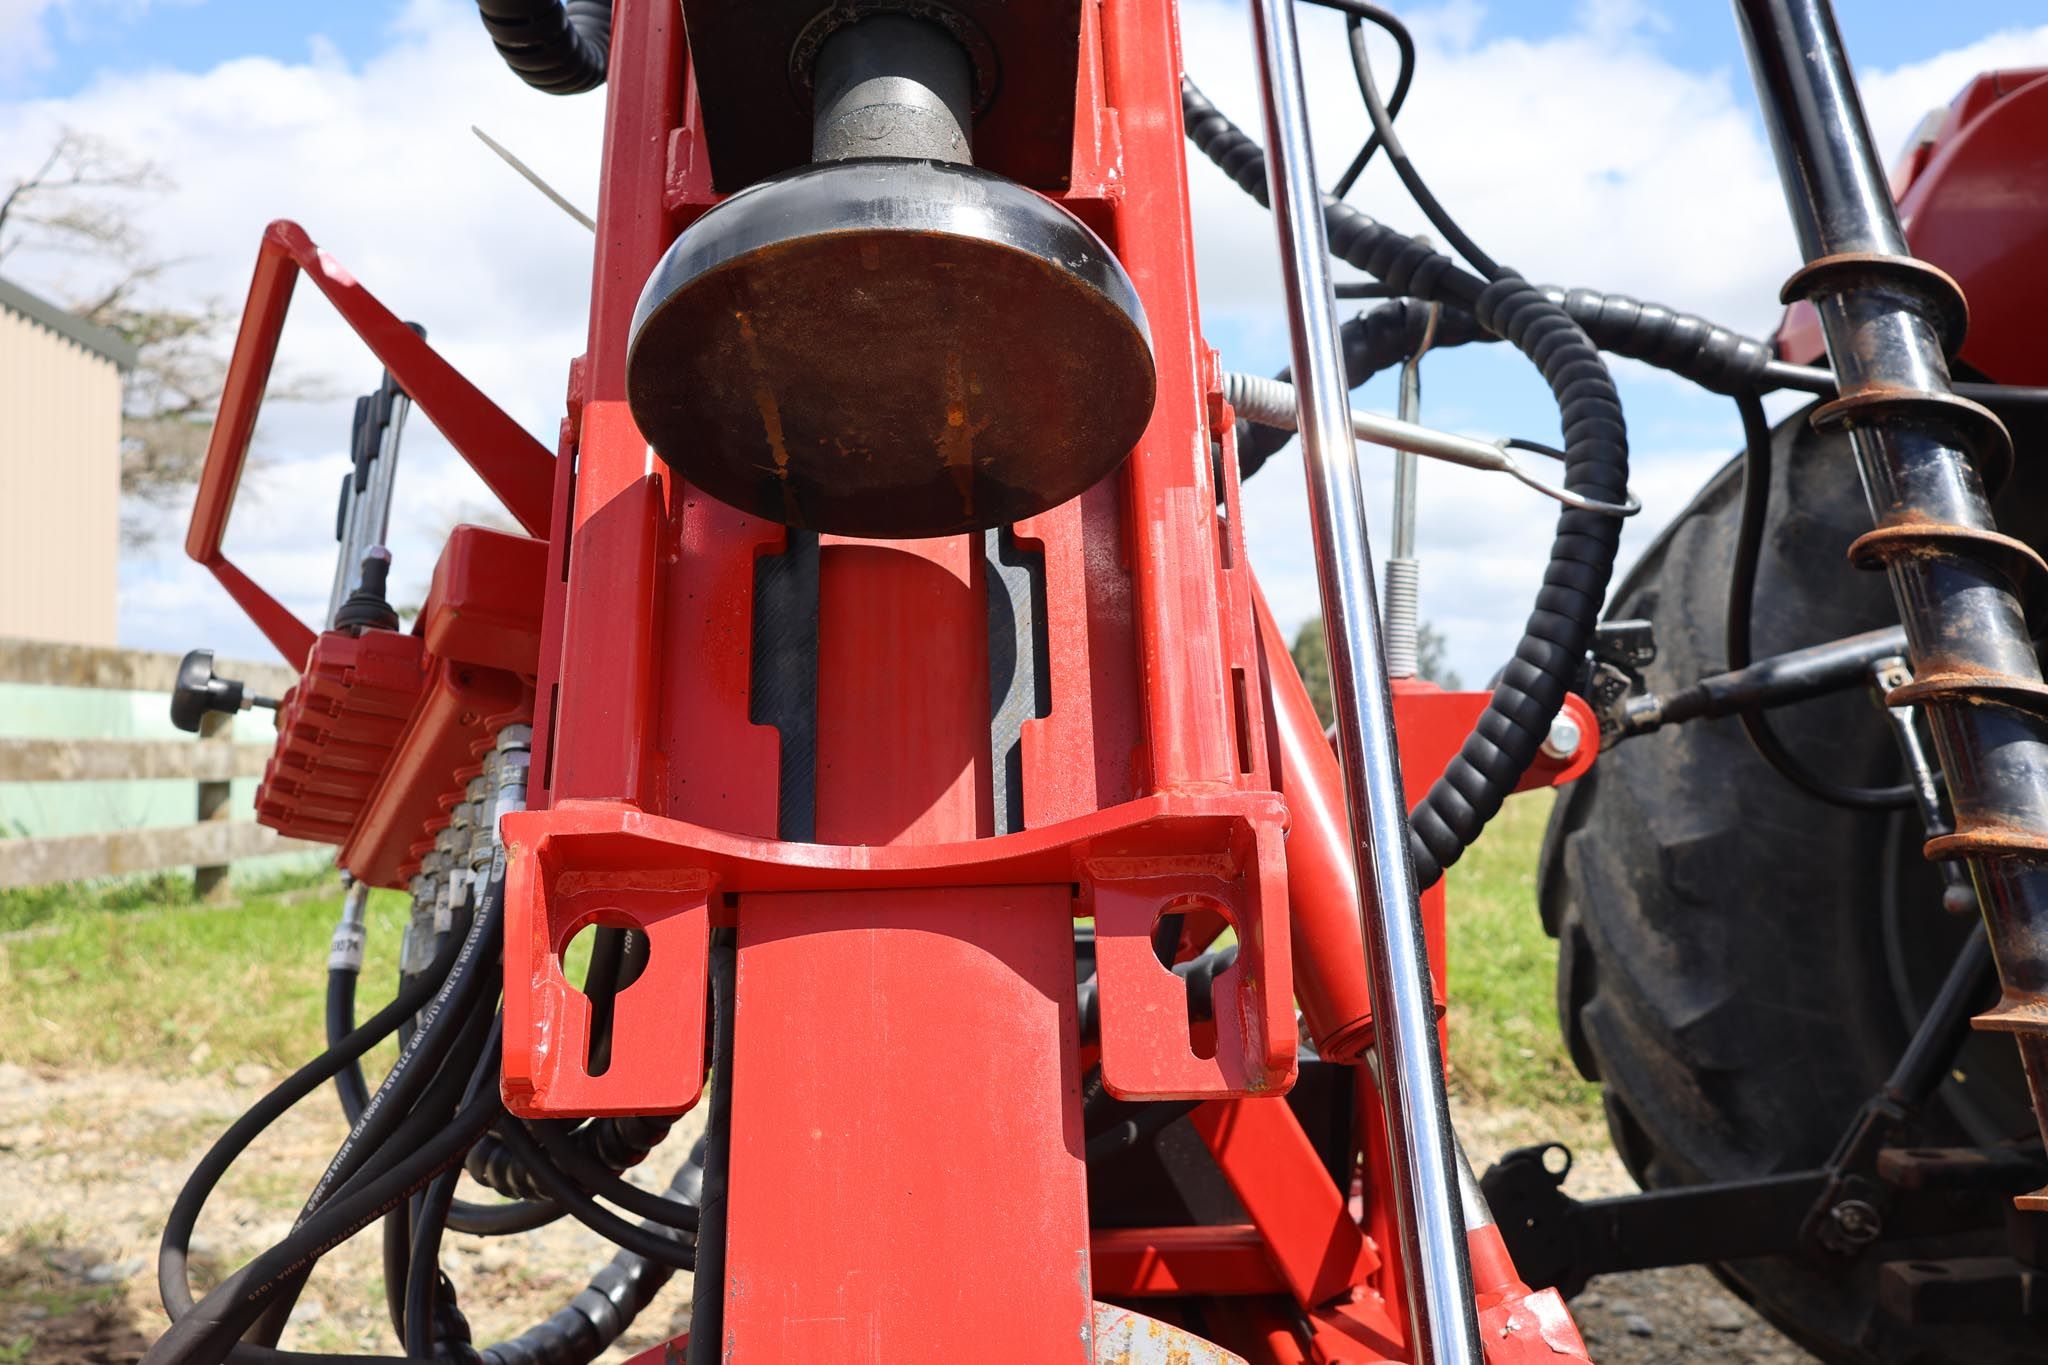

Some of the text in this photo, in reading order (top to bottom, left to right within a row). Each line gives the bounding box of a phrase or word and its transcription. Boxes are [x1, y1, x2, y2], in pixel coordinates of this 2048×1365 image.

[484, 896, 494, 913] DIN
[479, 914, 488, 927] EN
[460, 945, 475, 963] 2SN
[438, 967, 464, 1002] 12.7MM
[397, 1051, 412, 1070] 275
[382, 1069, 400, 1090] BAR
[364, 1091, 385, 1120] (4000
[351, 1119, 367, 1139] PSI)
[331, 1141, 353, 1171] MSHA
